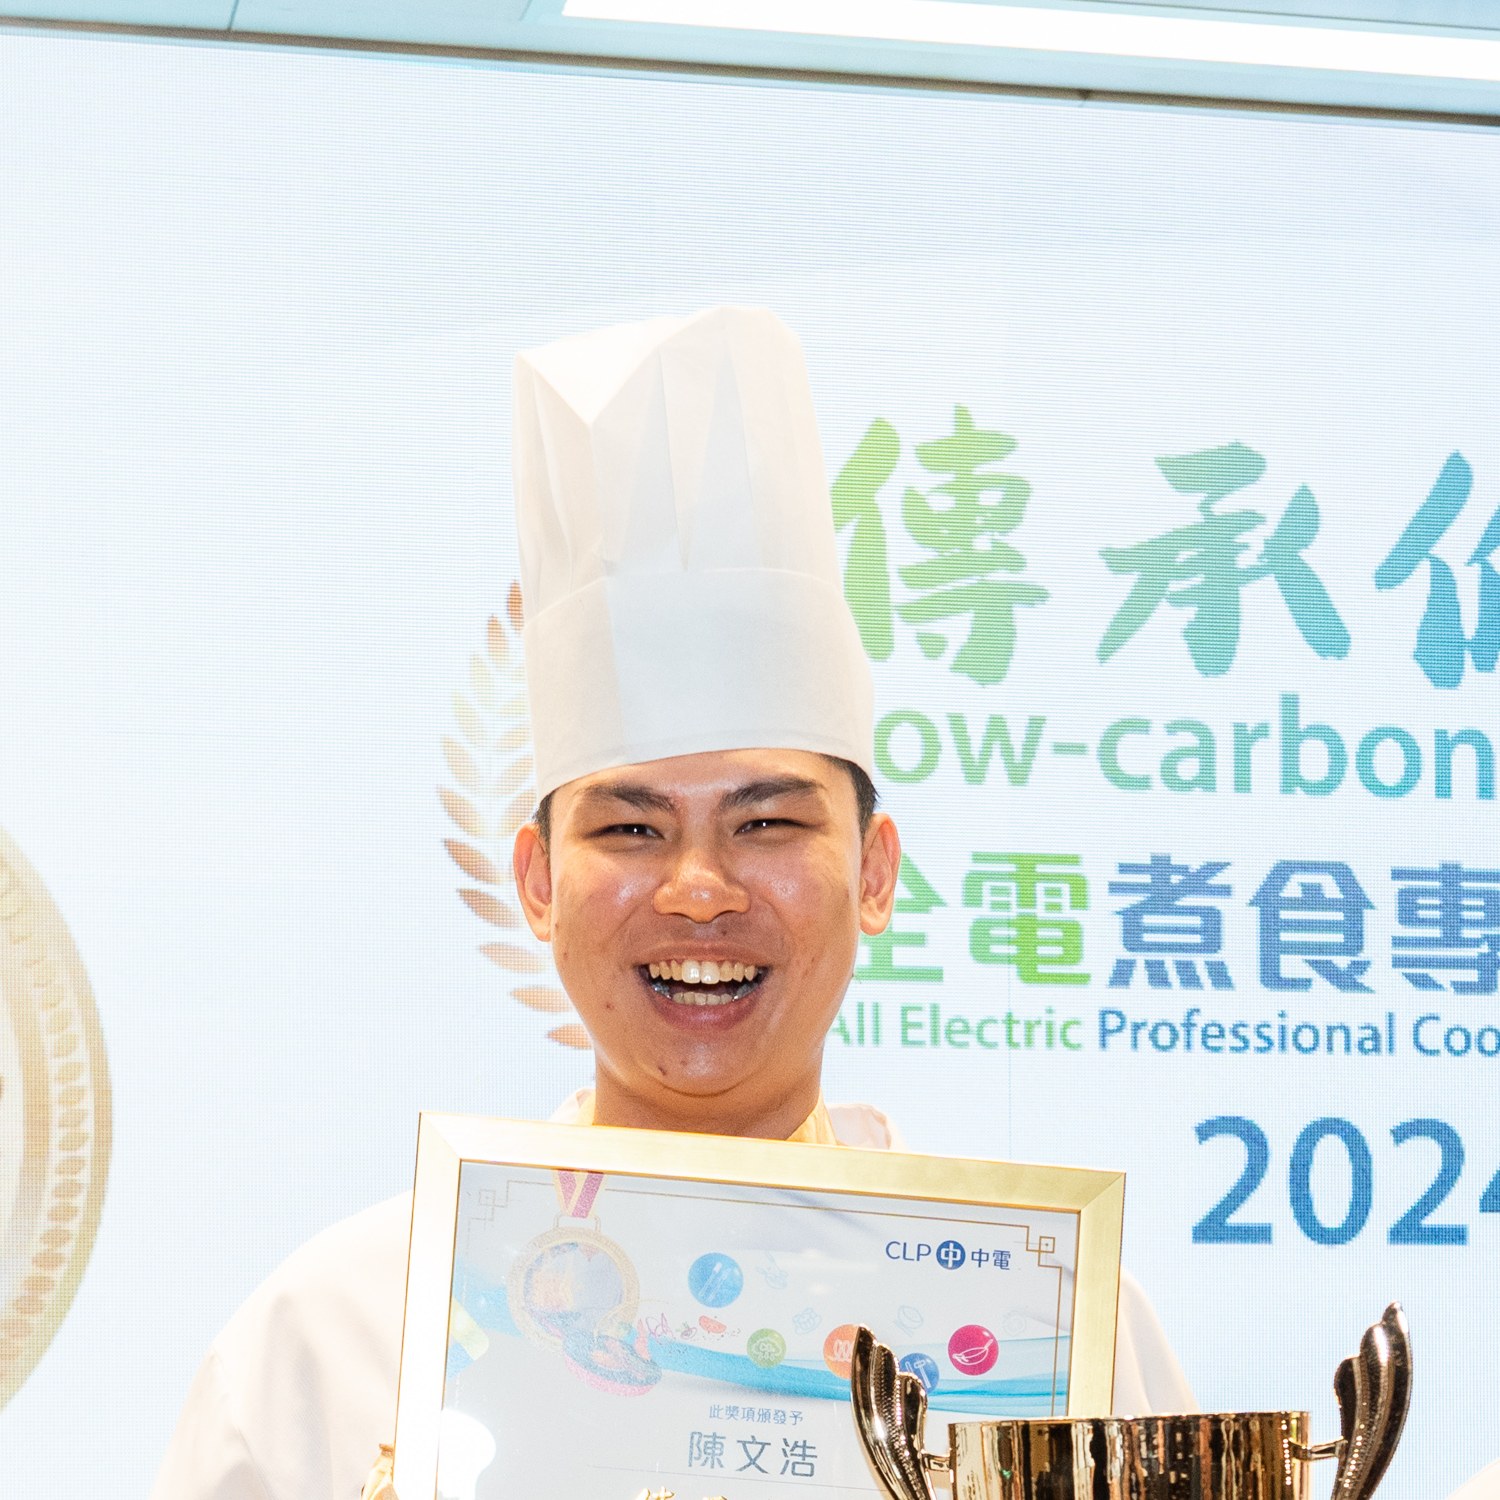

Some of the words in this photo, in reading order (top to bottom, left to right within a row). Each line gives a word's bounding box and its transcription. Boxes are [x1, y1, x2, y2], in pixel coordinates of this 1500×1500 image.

[873, 694, 1497, 802] ow-carbon
[901, 1002, 1082, 1052] Electric
[1100, 1006, 1395, 1056] Professional
[885, 1241, 931, 1262] CLP
[971, 1248, 1011, 1270] 中電
[708, 1404, 804, 1426] 此獎項頒發予
[688, 1431, 818, 1477] 陳文浩
